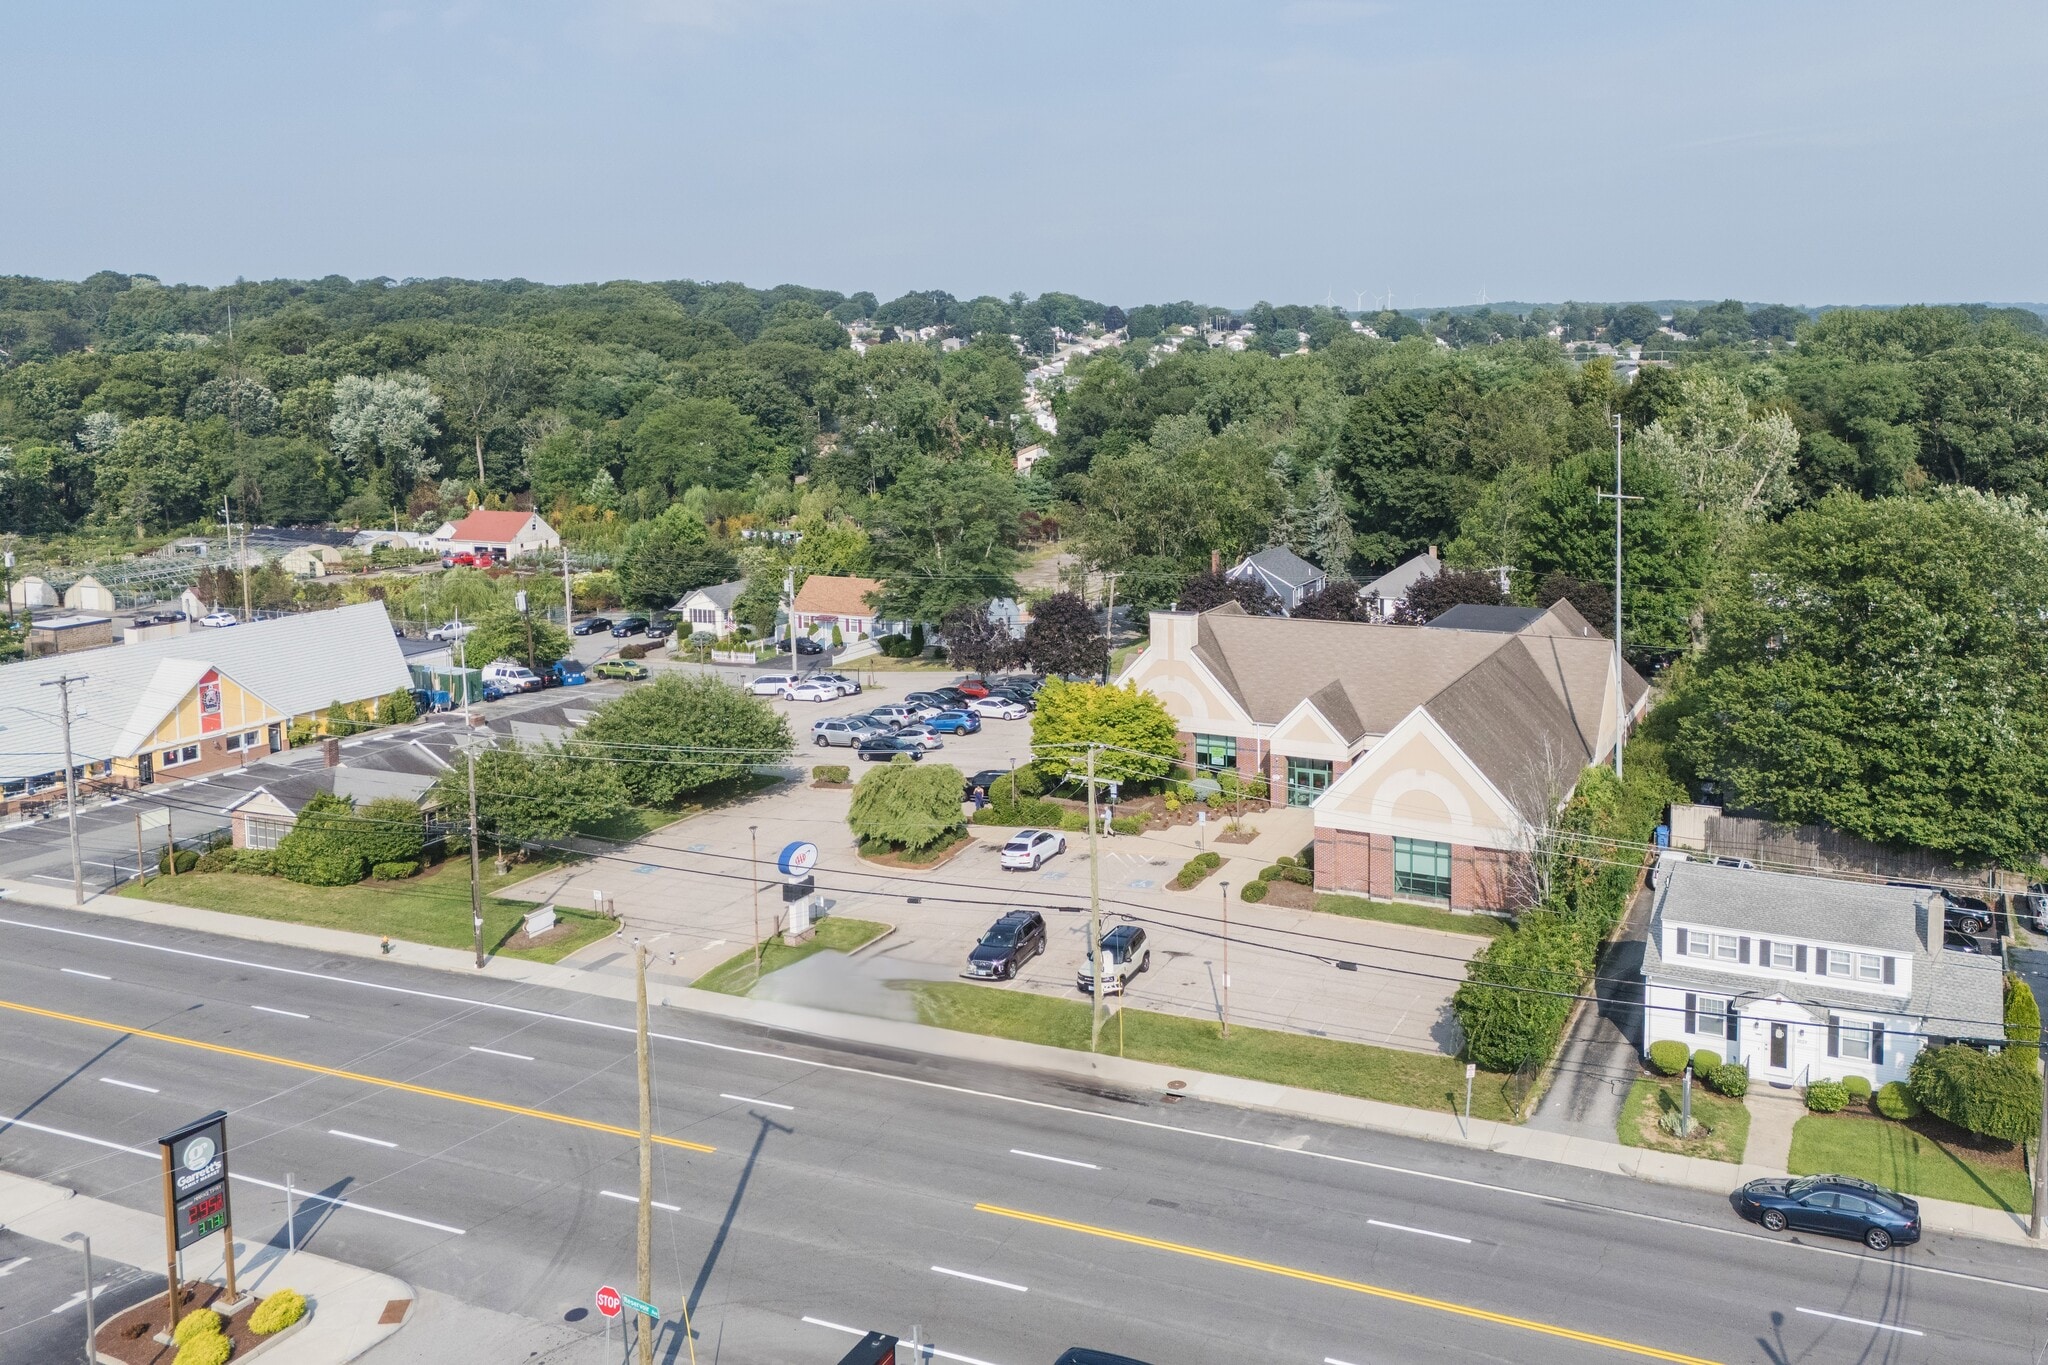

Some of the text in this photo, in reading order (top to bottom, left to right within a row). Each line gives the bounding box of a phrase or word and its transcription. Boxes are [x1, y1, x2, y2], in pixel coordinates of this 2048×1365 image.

[177, 1160, 222, 1188] Garrett's
[181, 1170, 220, 1191] FAMILY MARKET
[598, 1294, 620, 1309] STOP
[623, 1296, 650, 1311] Reservoir
